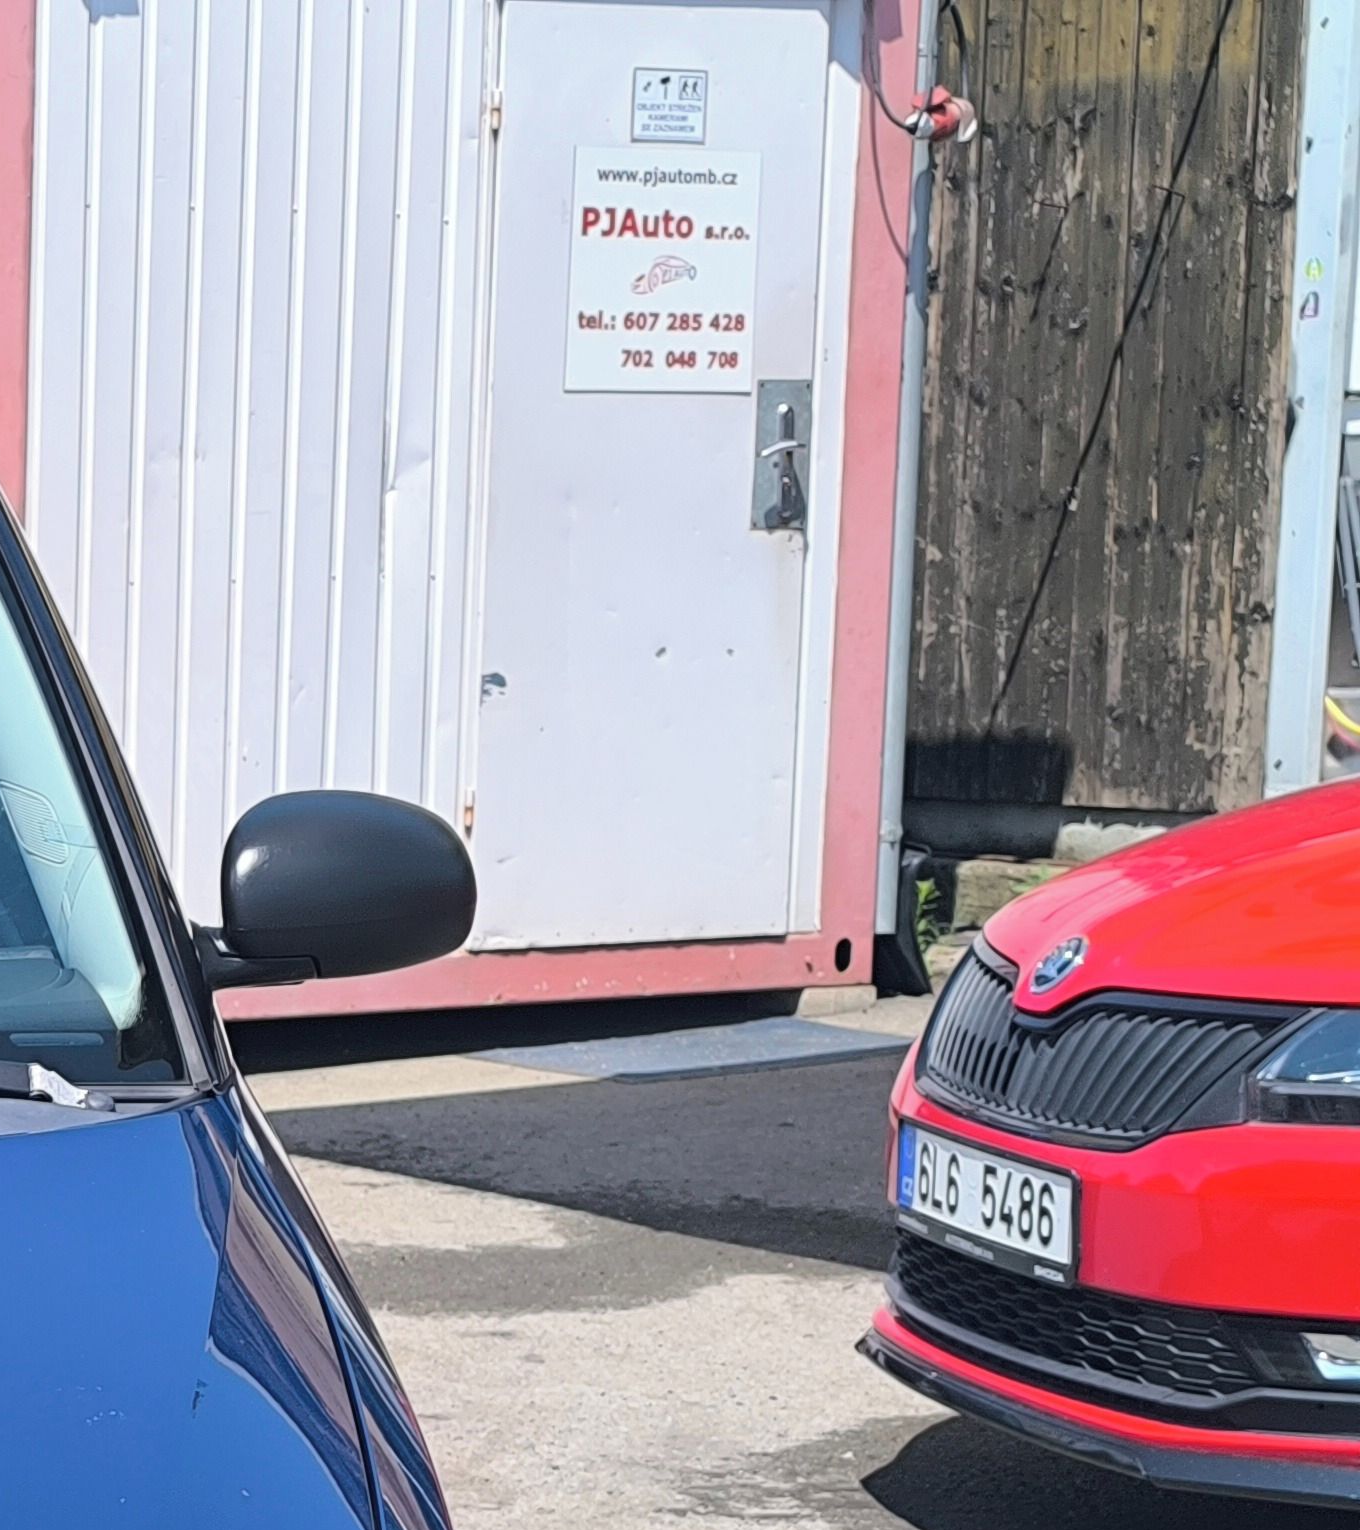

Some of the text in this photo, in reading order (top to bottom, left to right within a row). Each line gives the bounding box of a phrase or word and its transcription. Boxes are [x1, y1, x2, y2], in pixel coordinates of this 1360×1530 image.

[597, 166, 738, 188] www.pjautomb.cz
[581, 206, 750, 240] PJAuto s.r.o.
[578, 310, 745, 332] tel.: 607 285 428
[621, 349, 738, 369] 702 048 708
[918, 1141, 1055, 1247] 6L6 5486
